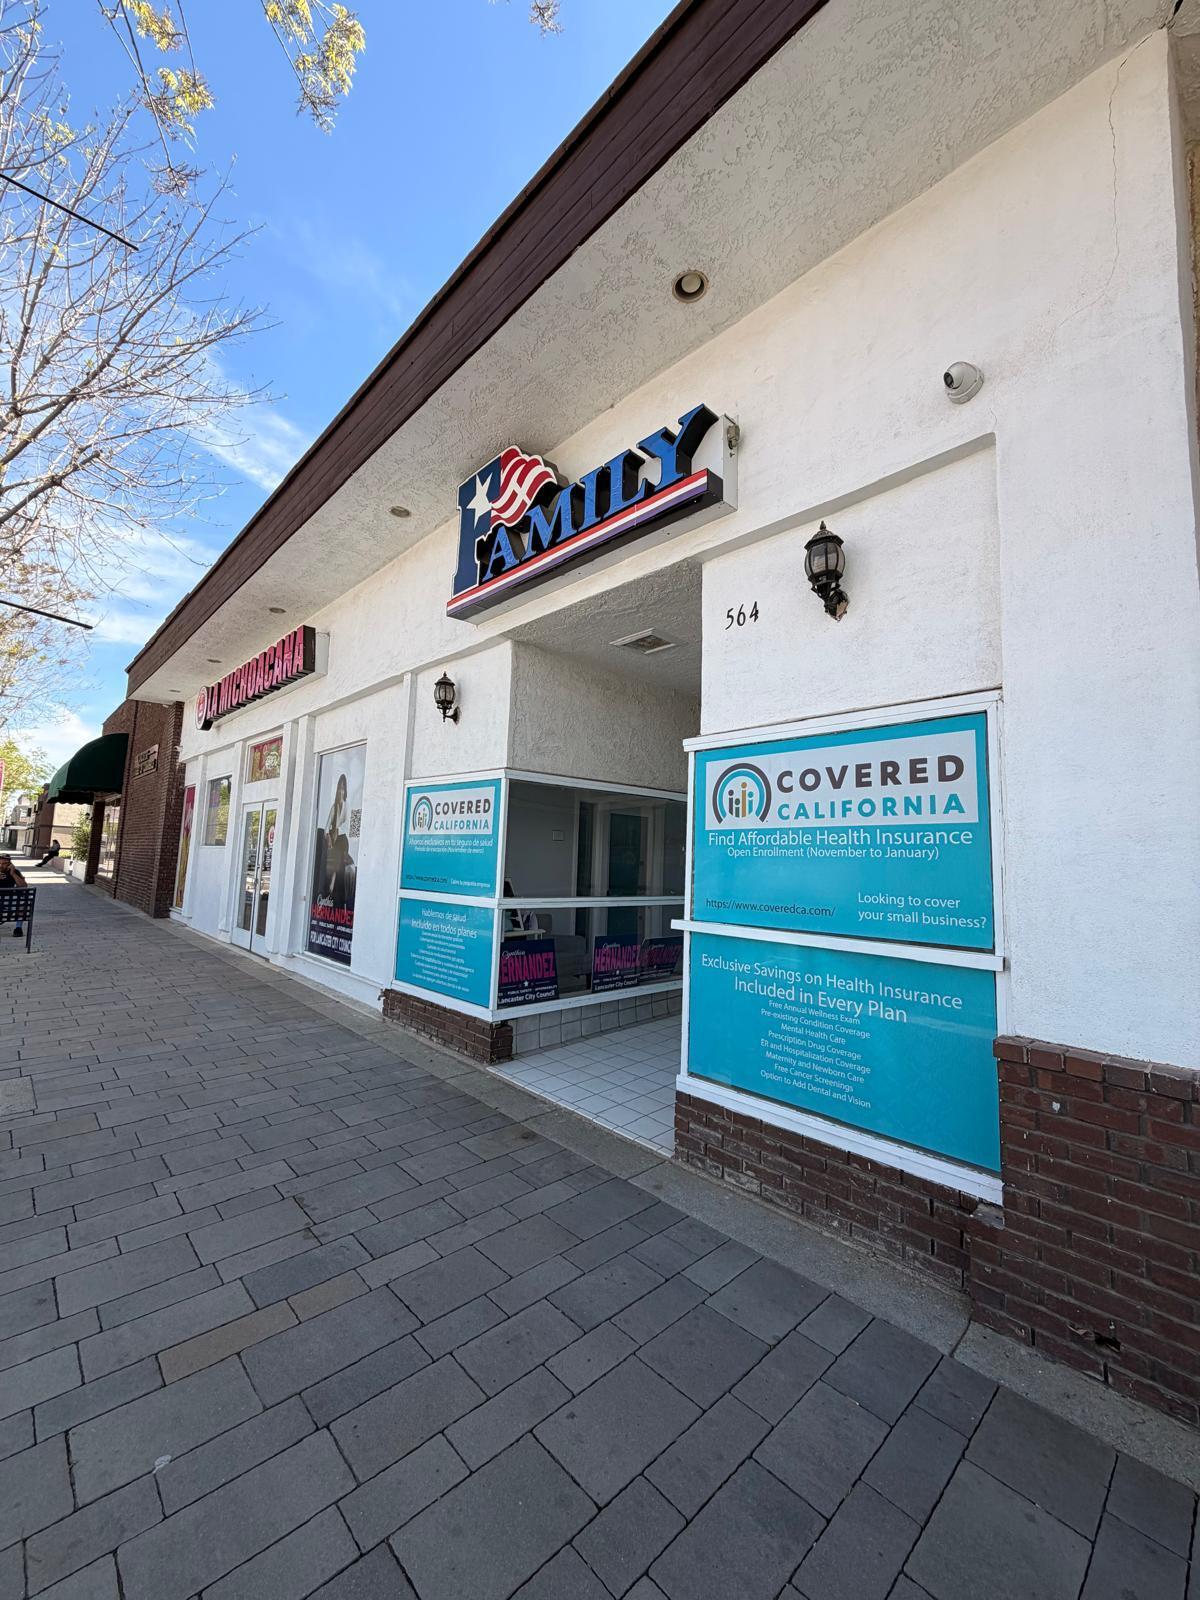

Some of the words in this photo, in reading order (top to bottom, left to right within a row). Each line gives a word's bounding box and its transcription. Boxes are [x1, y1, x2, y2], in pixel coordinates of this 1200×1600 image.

[452, 403, 716, 599] FAMILY
[725, 601, 759, 630] 564
[207, 682, 220, 720] LA
[219, 625, 304, 714] MICHOACANA
[776, 754, 965, 793] COVERED
[434, 798, 491, 815] COVERED
[777, 793, 966, 821] CALIFORNIA
[433, 819, 489, 830] CALIFORNIA
[708, 832, 735, 846] Find
[738, 830, 812, 846] Affordable
[816, 829, 870, 846] Health
[876, 828, 973, 845] Insurance
[727, 848, 751, 858] Open
[752, 846, 804, 858] Enrollment
[806, 847, 868, 858] (November
[870, 848, 883, 858] to
[885, 846, 939, 861] January)
[705, 898, 836, 917] https://www.coveredca.com/
[858, 893, 906, 909] Looking
[908, 896, 922, 907] to
[924, 898, 961, 909] cover
[432, 923, 440, 931] en
[440, 923, 457, 935] todos
[457, 927, 477, 938] planes
[858, 912, 884, 923] your
[887, 911, 919, 925] small
[921, 912, 987, 928] business?
[499, 952, 555, 985] ERNANDEZ
[595, 945, 640, 972] HERNANDEZ
[536, 990, 555, 999] Council
[702, 953, 751, 974] Exclusive
[754, 963, 801, 983] Savings
[805, 973, 822, 986] on
[826, 974, 875, 995] Health
[879, 981, 962, 1009] Insurance
[735, 977, 795, 1001] Included
[800, 988, 813, 1004] in
[818, 991, 864, 1017] Every
[869, 1000, 908, 1023] Plan
[769, 1000, 783, 1010] Free
[784, 1003, 807, 1014] Annual
[808, 1008, 839, 1021] Wellness
[840, 1014, 861, 1025] Exam
[760, 1008, 799, 1024] Pre-existing
[800, 1016, 834, 1031] Condition
[835, 1024, 872, 1039] Coverage
[780, 1023, 804, 1034] Mental
[805, 1028, 828, 1040] Health
[829, 1034, 846, 1045] Care
[760, 1038, 769, 1048] ER
[770, 1041, 782, 1051] and
[783, 1044, 834, 1064] Hospitalization
[835, 1058, 872, 1074] Coverage
[768, 1030, 807, 1047] Prescription
[808, 1040, 826, 1053] Drug
[826, 1045, 862, 1061] Coverage
[766, 1051, 797, 1067] Maternity
[797, 1059, 811, 1069] and
[812, 1062, 846, 1078] Newborn
[846, 1073, 865, 1084] Care
[774, 1063, 789, 1074] Free
[789, 1068, 813, 1080] Cancer
[814, 1075, 854, 1093] Screenings
[760, 1069, 783, 1083] Option
[784, 1076, 791, 1085] to
[792, 1079, 807, 1089] Add
[807, 1083, 832, 1097] Dental
[832, 1090, 847, 1101] and
[847, 1094, 871, 1109] Vision
